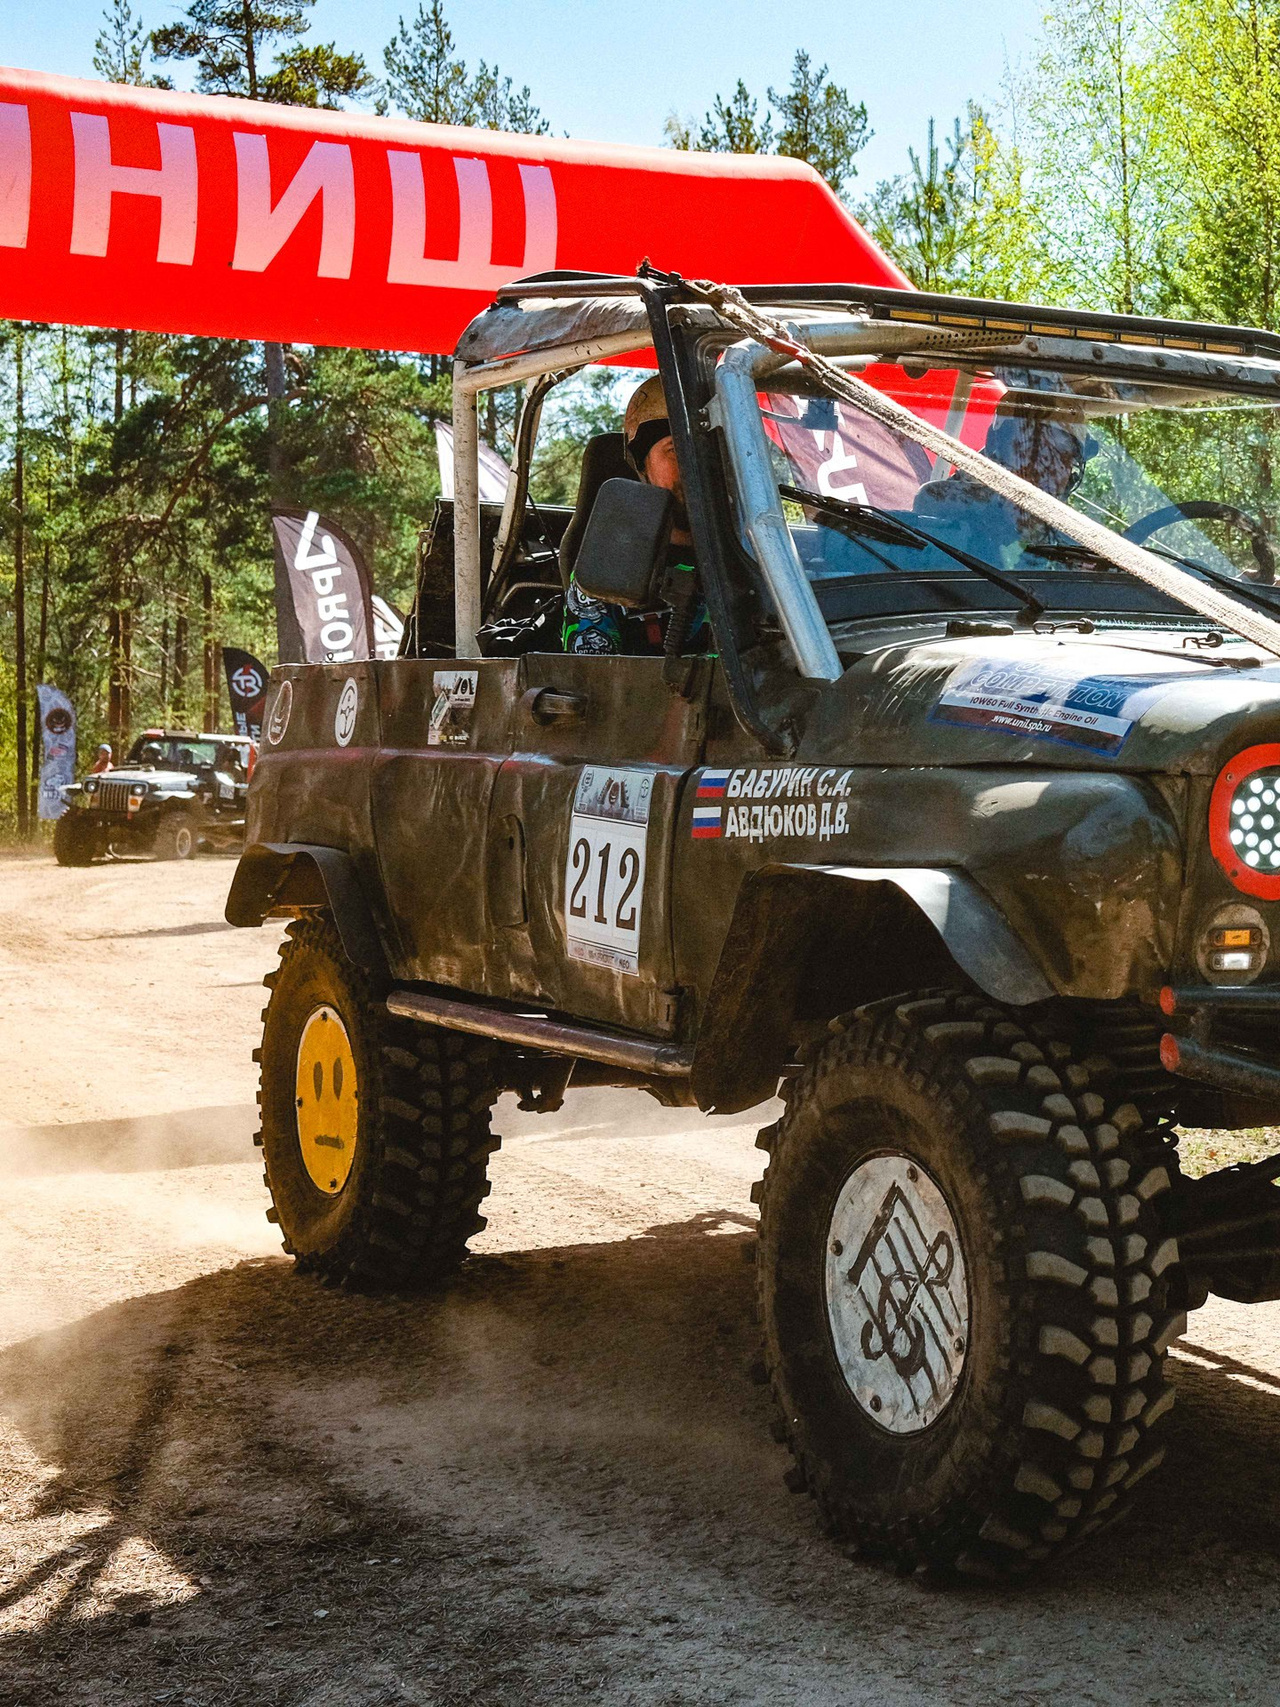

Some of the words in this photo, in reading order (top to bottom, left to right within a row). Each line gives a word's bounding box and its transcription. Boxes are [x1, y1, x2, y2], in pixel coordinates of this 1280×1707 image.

[970, 671, 1132, 710] COMPETITION
[998, 700, 1014, 710] Full
[1054, 710, 1083, 723] Engine
[1084, 716, 1098, 725] Oil
[727, 768, 820, 798] БАБУРИН
[816, 768, 854, 798] С.А.
[725, 803, 816, 844] АВДЮКОВ
[819, 801, 849, 842] Д.В.
[569, 838, 640, 931] 212
